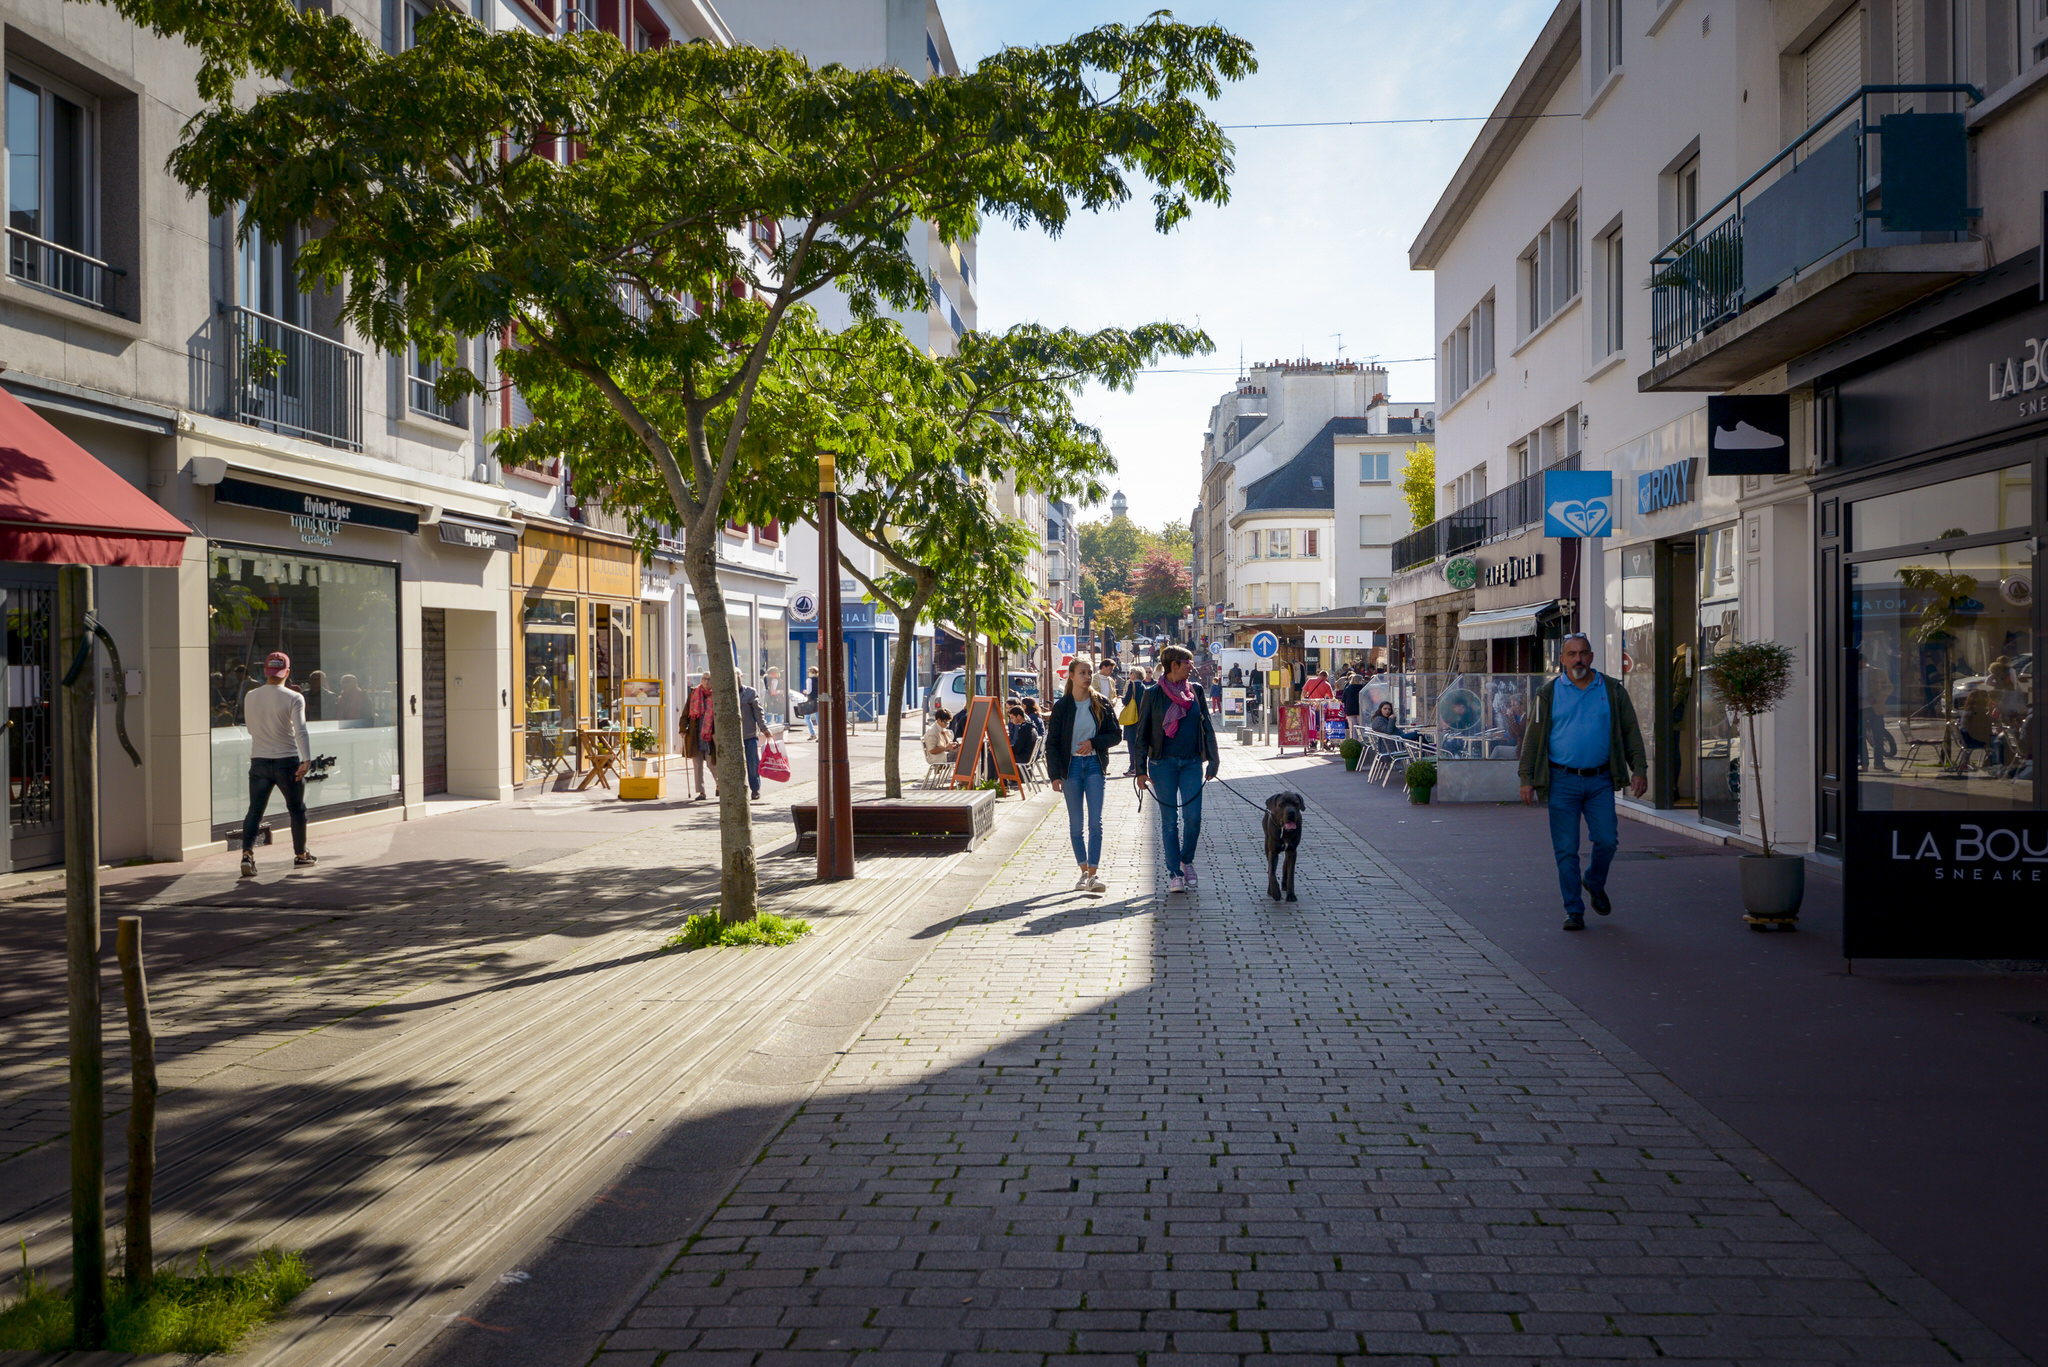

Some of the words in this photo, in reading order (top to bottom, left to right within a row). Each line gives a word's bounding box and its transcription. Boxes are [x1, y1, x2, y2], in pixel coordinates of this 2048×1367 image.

[1989, 357, 2017, 401] LA
[1652, 457, 1690, 511] ROXY
[304, 496, 329, 519] flying
[330, 501, 351, 521] tiger
[465, 528, 482, 547] flying
[482, 530, 496, 548] tiger
[1449, 559, 1474, 570] CAFE
[1485, 562, 1505, 587] CAFE
[1514, 553, 1538, 580] DIEM
[1450, 576, 1474, 588] DIEM
[1310, 634, 1363, 645] ACCUEIL
[1892, 830, 1942, 860] LA
[1955, 824, 2048, 862] BOU
[1935, 868, 2041, 882] SNEAKE
